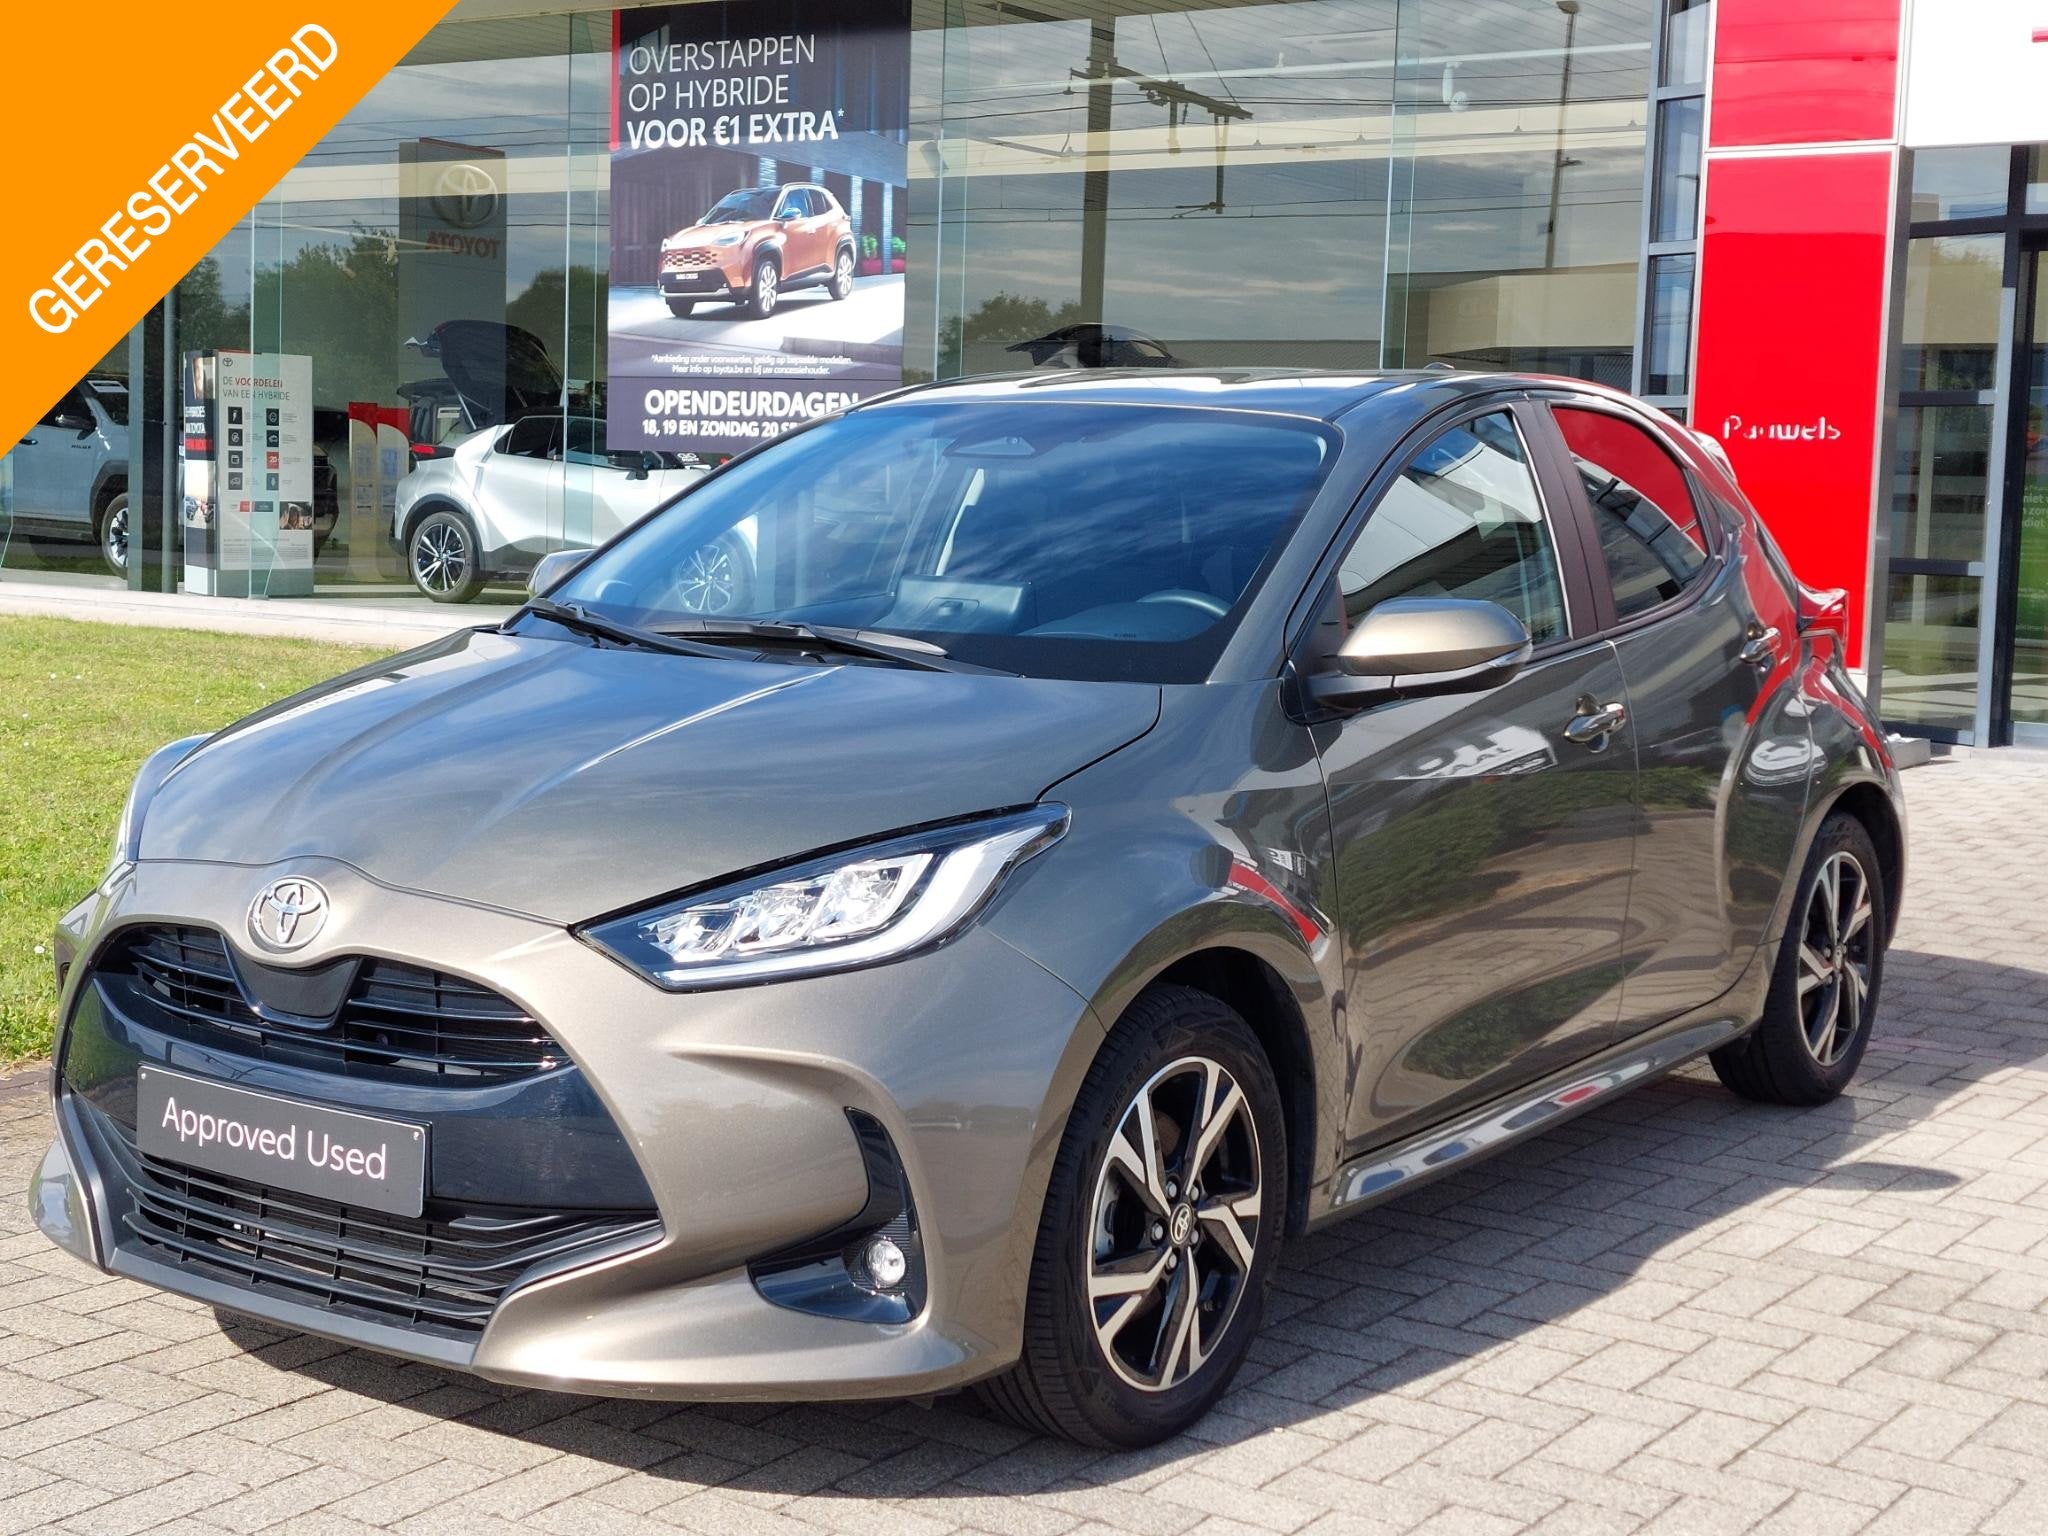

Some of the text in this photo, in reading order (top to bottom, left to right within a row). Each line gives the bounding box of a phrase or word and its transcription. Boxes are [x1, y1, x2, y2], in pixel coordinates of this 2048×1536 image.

[629, 34, 816, 75] OVERSTAPPEN
[629, 74, 789, 112] OP HYBRIDE
[626, 117, 707, 150] VOOR
[713, 114, 740, 145] €1
[223, 376, 233, 385] DE
[258, 391, 290, 400] HYBRIDE
[644, 389, 859, 418] OPENDEURDAGEN
[642, 419, 660, 437] 18,
[662, 419, 677, 435] 19
[679, 420, 698, 436] EN
[700, 421, 760, 438] ZONDAG
[761, 422, 779, 438] 20
[162, 1097, 387, 1180] Approved Used
